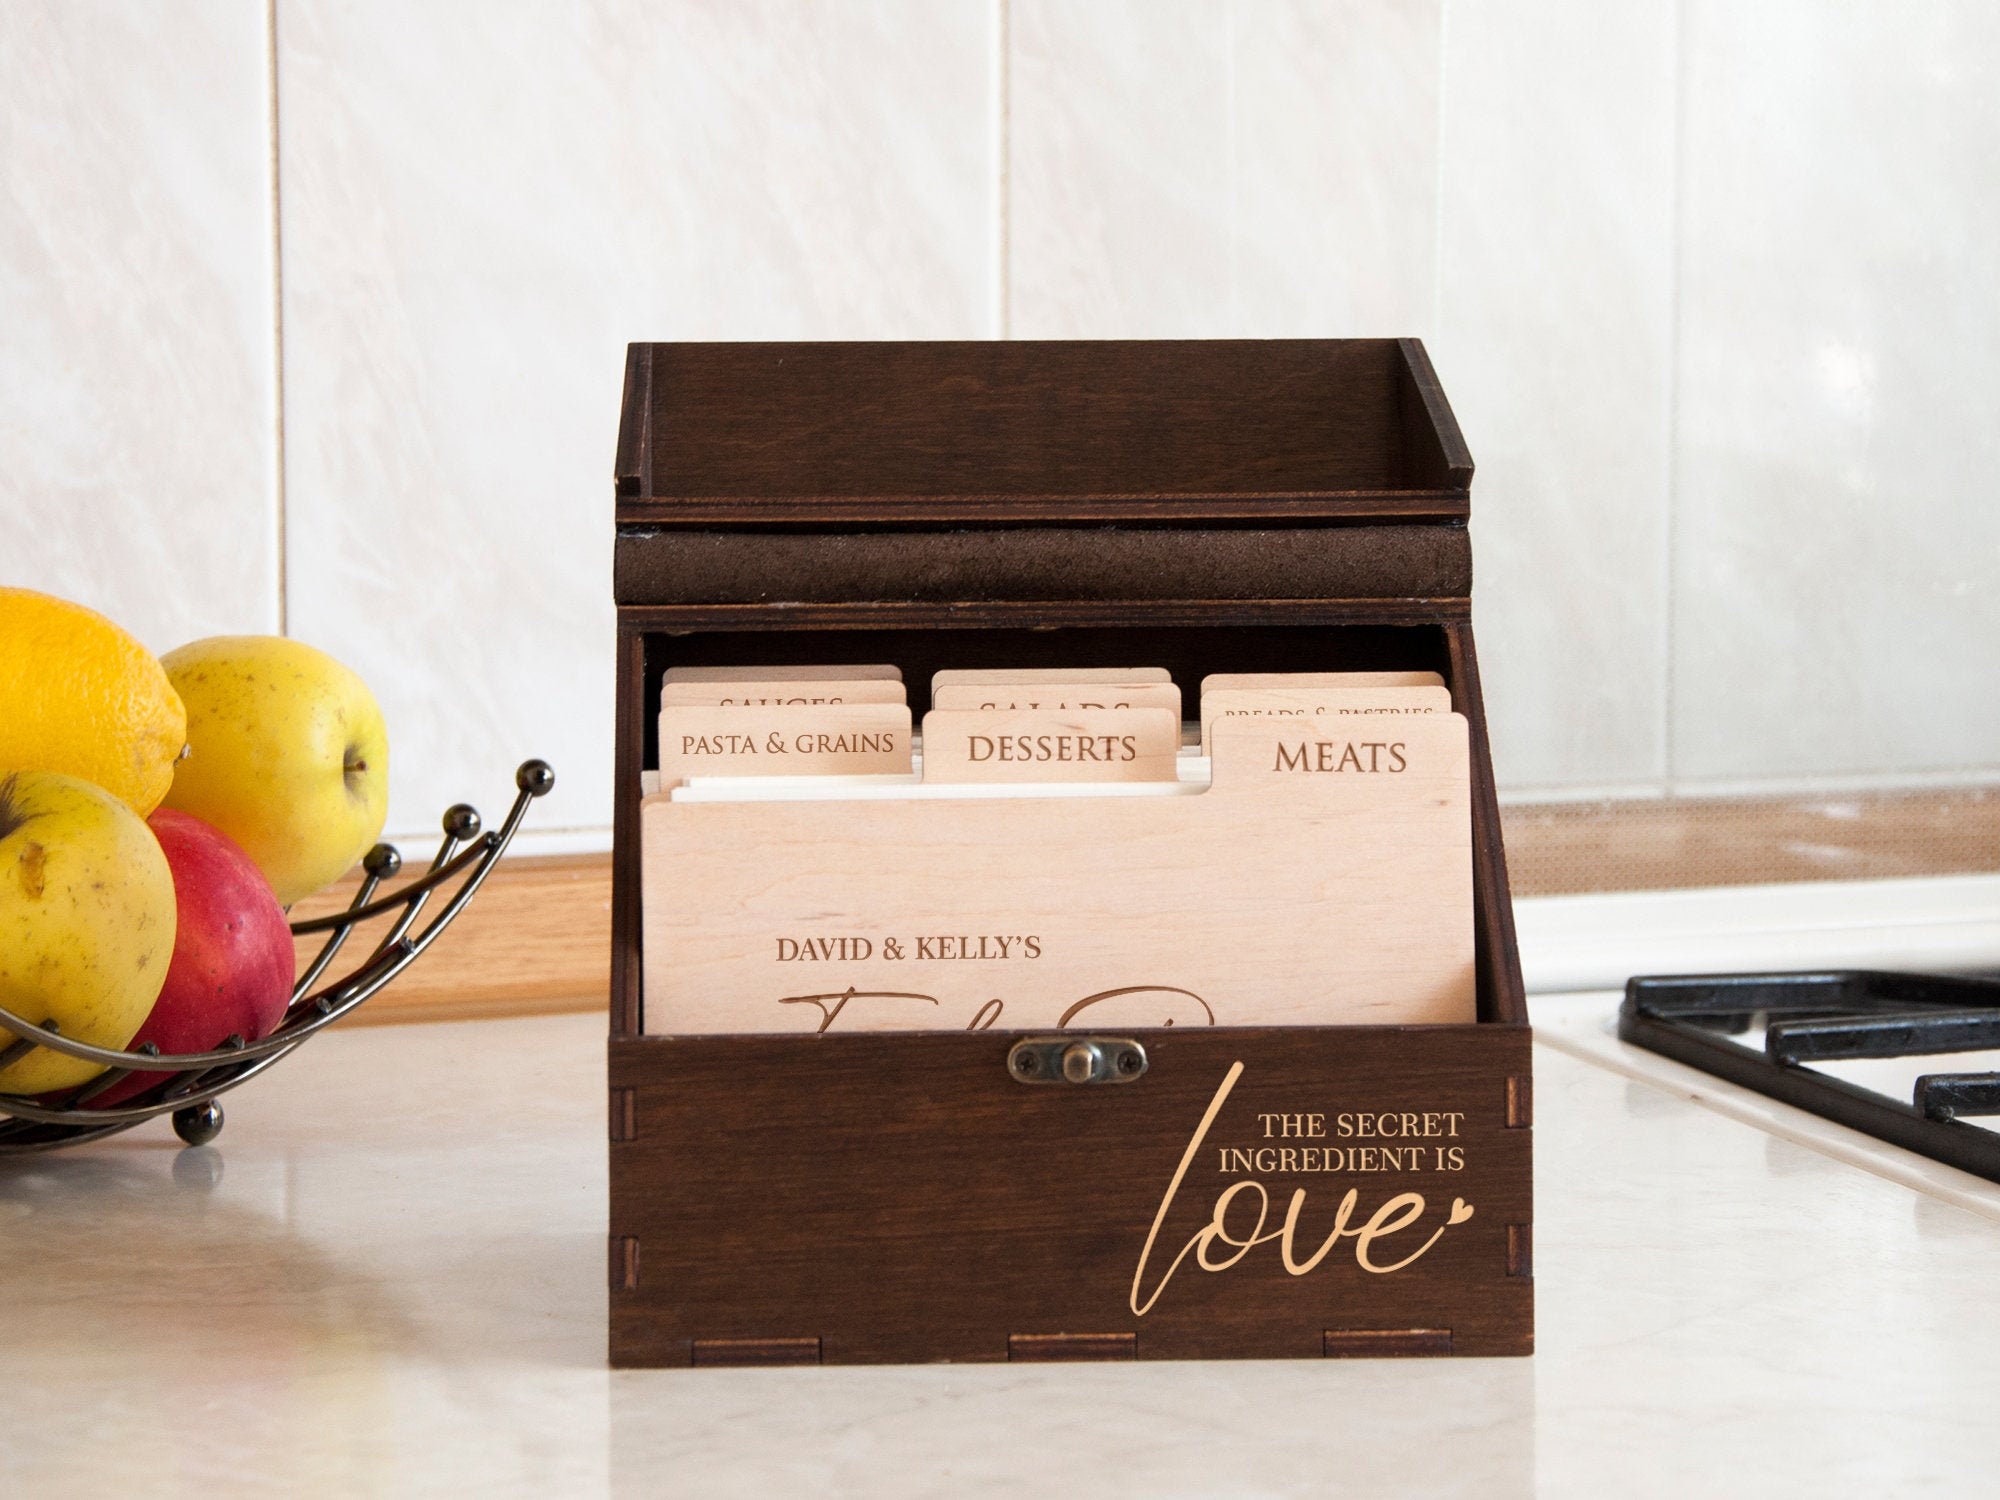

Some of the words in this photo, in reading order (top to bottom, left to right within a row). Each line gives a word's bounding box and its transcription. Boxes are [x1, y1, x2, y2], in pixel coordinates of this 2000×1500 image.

[681, 735, 758, 755] PASTA
[766, 731, 788, 754] &
[795, 733, 894, 754] GRAINS
[967, 735, 1136, 762] DESSERTS
[1272, 741, 1407, 773] MEATS
[775, 937, 873, 962] DAVID
[882, 937, 906, 960] &
[914, 935, 1042, 961] KELLY'S
[1258, 1113, 1326, 1138] THE
[1336, 1112, 1465, 1138] SECRET
[1218, 1147, 1426, 1173] INGREDIENT
[1435, 1147, 1465, 1171] IS
[1130, 1060, 1446, 1317] love
